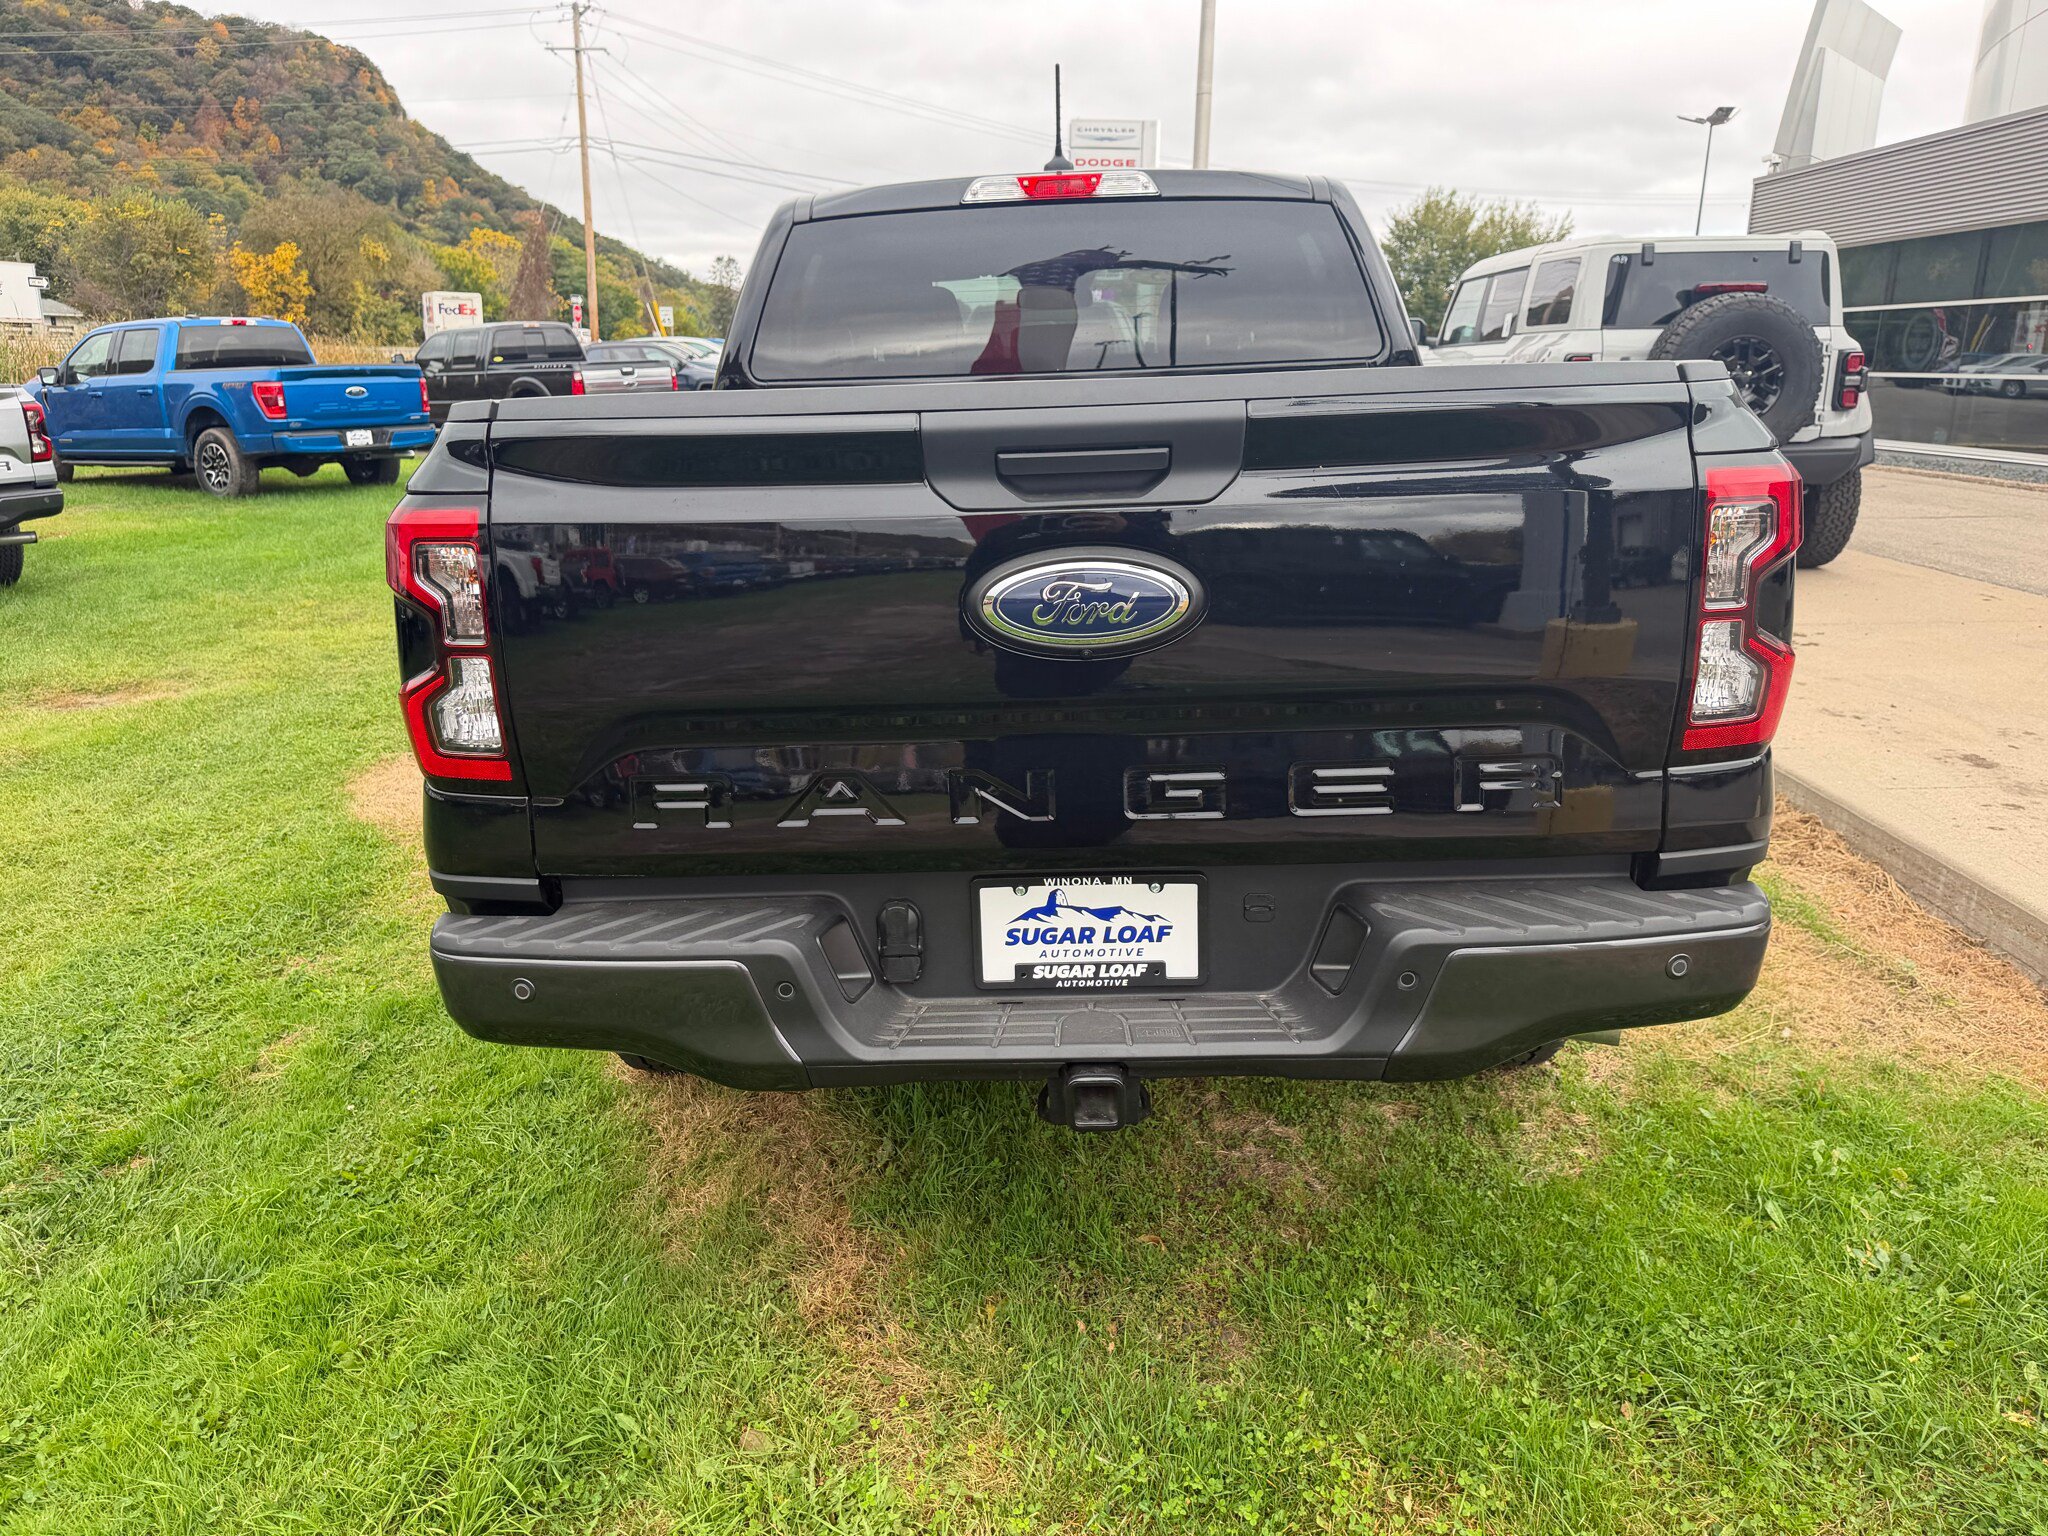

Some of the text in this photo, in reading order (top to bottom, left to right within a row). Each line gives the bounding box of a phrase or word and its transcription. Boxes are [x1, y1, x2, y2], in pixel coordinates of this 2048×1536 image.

[1075, 158, 1137, 167] DODGE
[438, 303, 477, 315] FedEx
[1032, 580, 1141, 626] Ford
[630, 757, 1563, 829] RANGER
[1043, 876, 1133, 886] WINONA, MN
[1004, 925, 1174, 946] SUGAR LOAF
[1039, 947, 1145, 959] AUTOMOTIVE
[1032, 963, 1149, 979] SUGAR LOAF
[1055, 979, 1129, 988] AUTOMOTIVE
